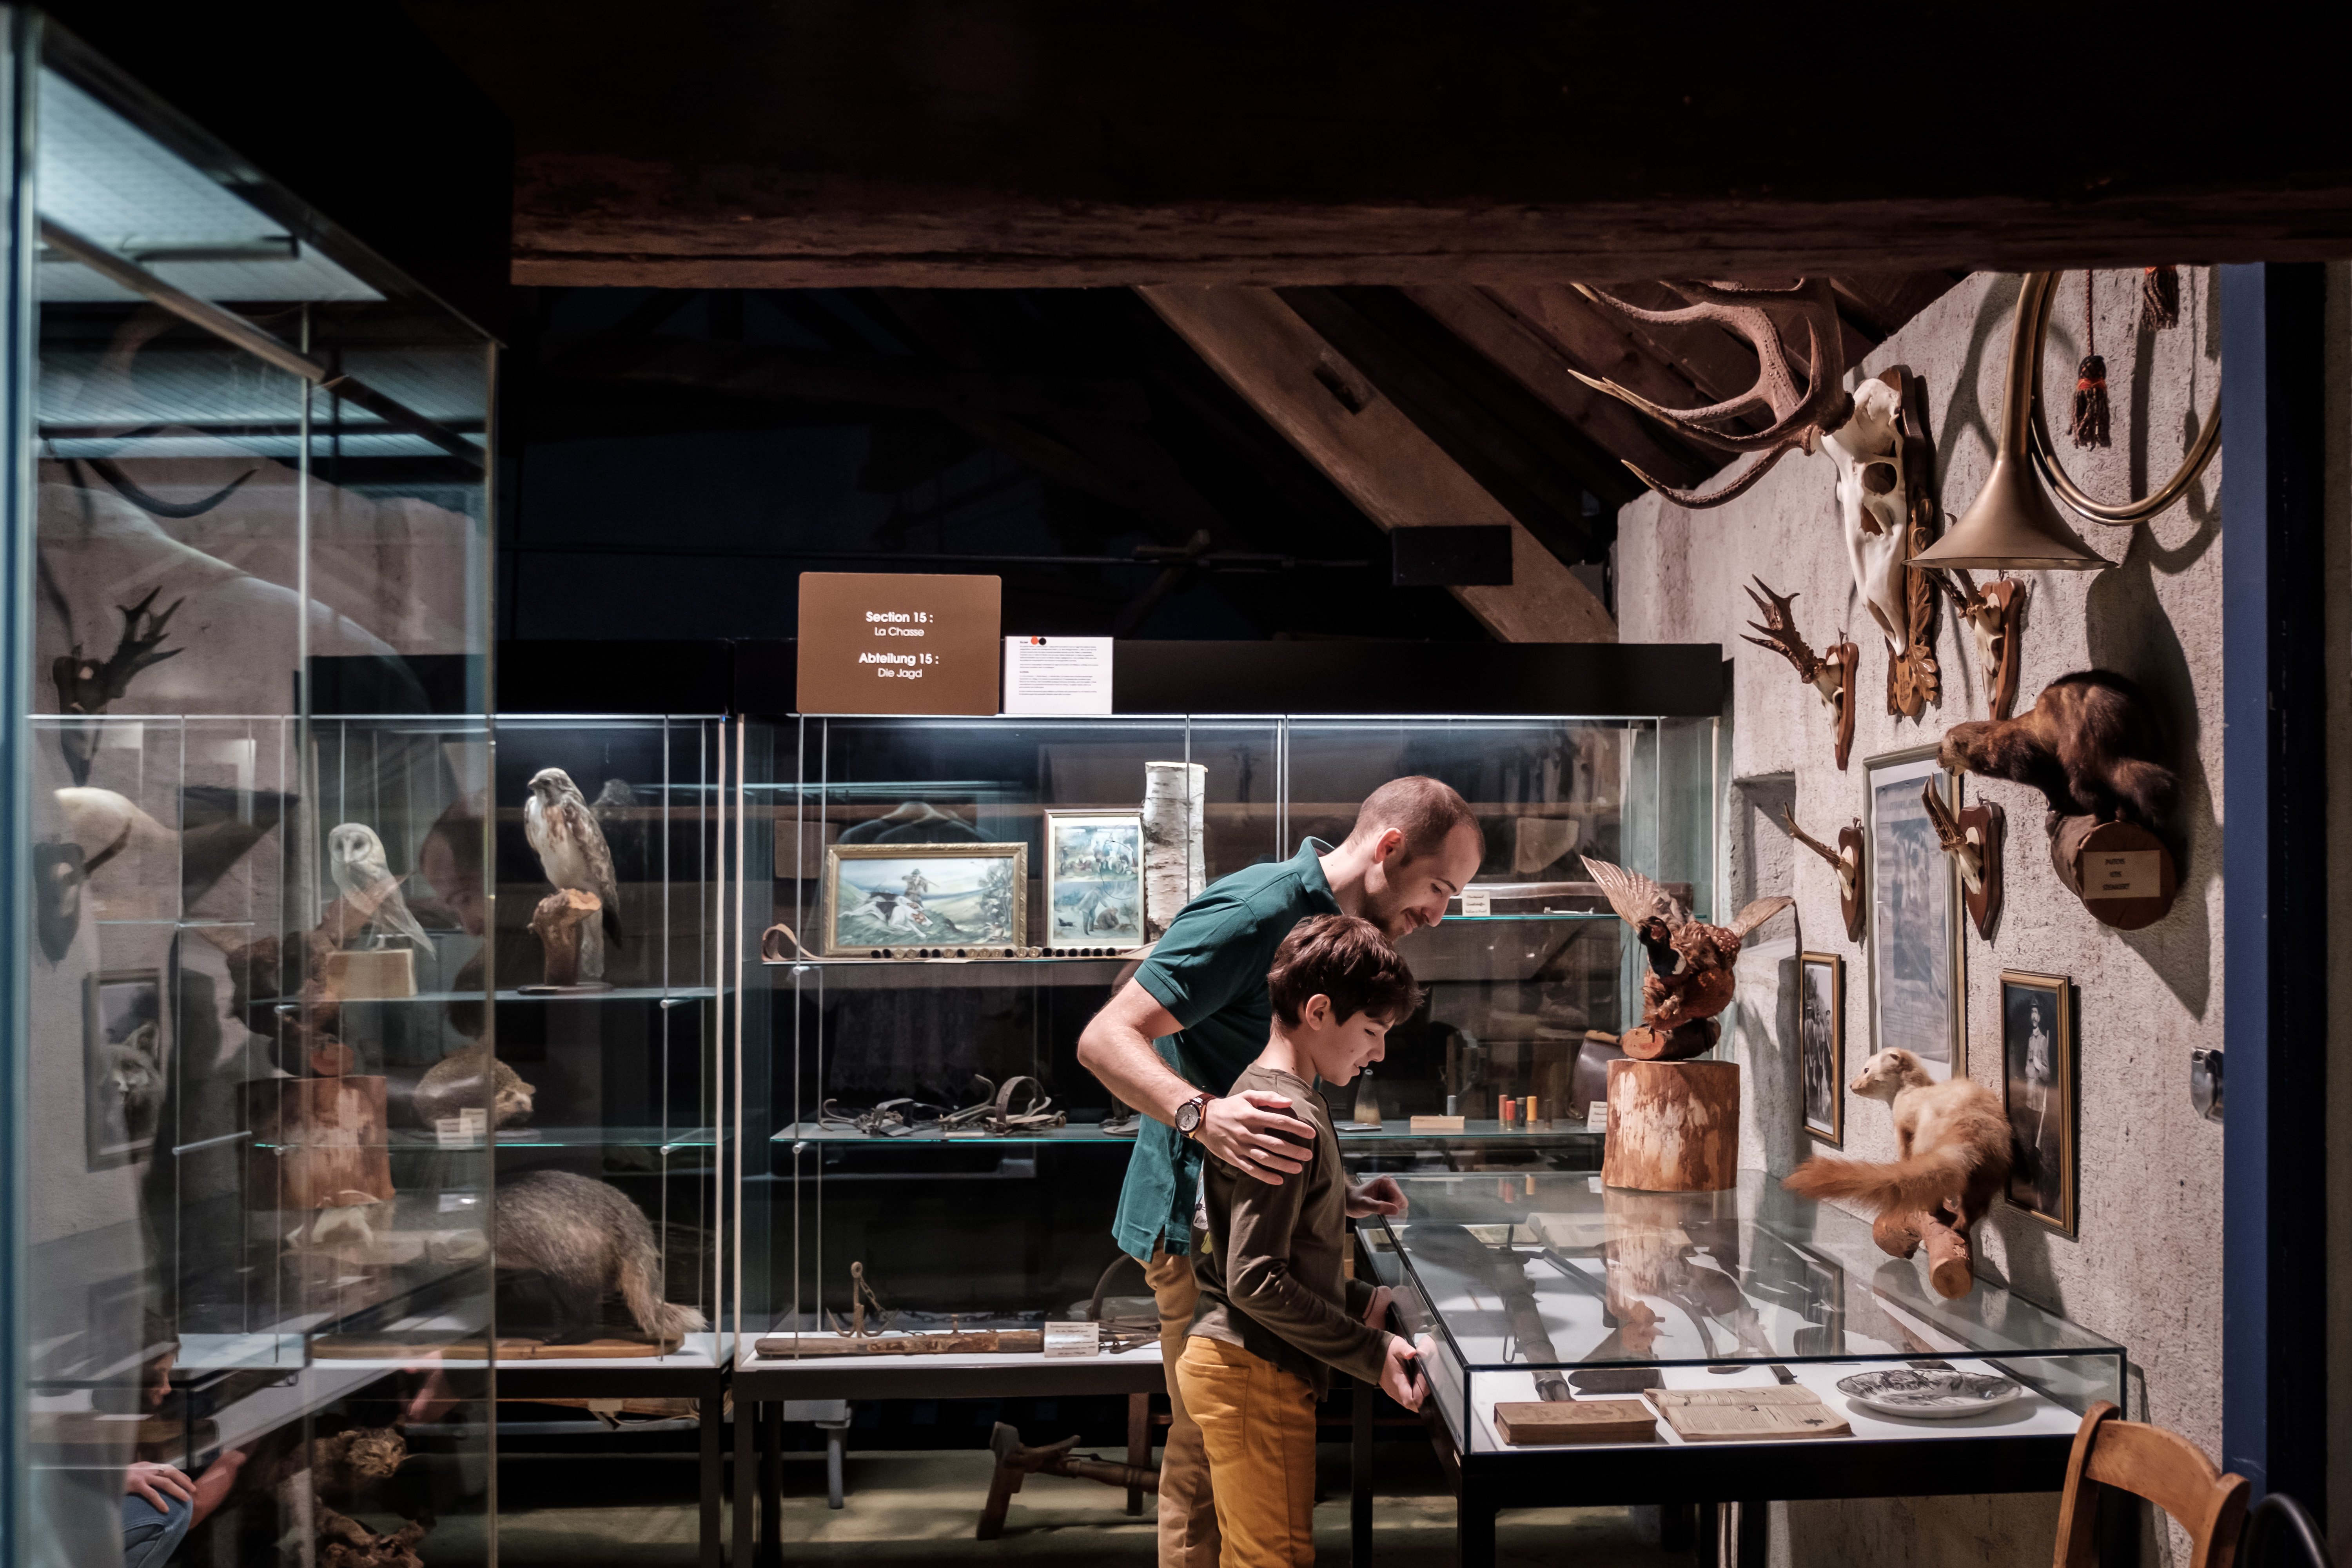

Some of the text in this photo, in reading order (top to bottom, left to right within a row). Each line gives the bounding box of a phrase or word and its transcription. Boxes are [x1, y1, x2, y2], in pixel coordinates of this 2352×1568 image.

[866, 611, 910, 622] Section
[875, 626, 925, 637] La Chasse
[858, 652, 916, 666] Abteilung
[878, 668, 922, 680] Die Jagd
